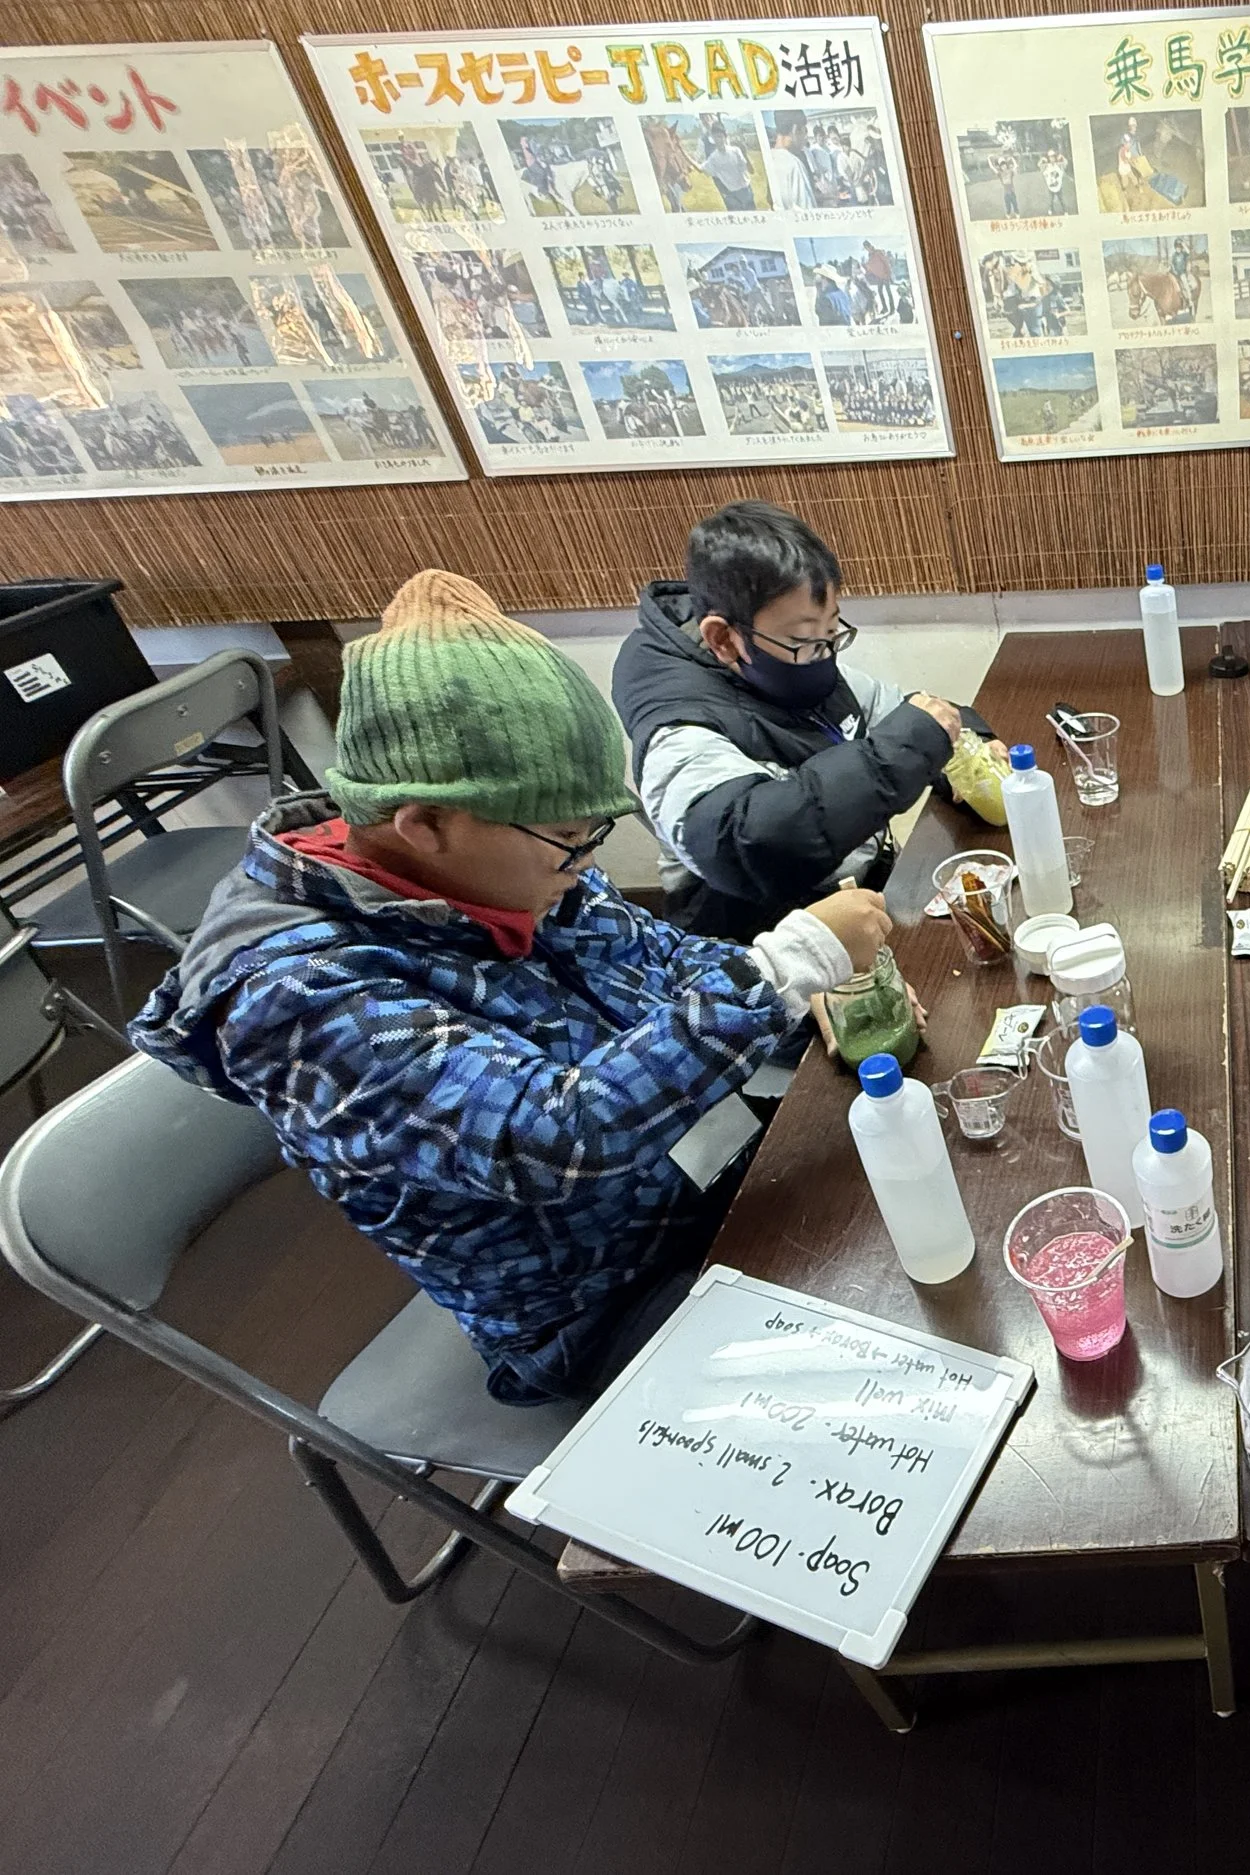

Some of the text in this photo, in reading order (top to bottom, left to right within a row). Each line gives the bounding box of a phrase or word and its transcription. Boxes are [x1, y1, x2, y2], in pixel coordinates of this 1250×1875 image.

[765, 1311, 805, 1336] soap
[890, 1352, 936, 1376] water
[855, 1378, 904, 1407] well
[937, 1367, 973, 1391] Hot
[637, 1419, 718, 1457] spoonfuls
[716, 1443, 773, 1474] small
[891, 1444, 934, 1473] Hot
[771, 1461, 792, 1487] 2
